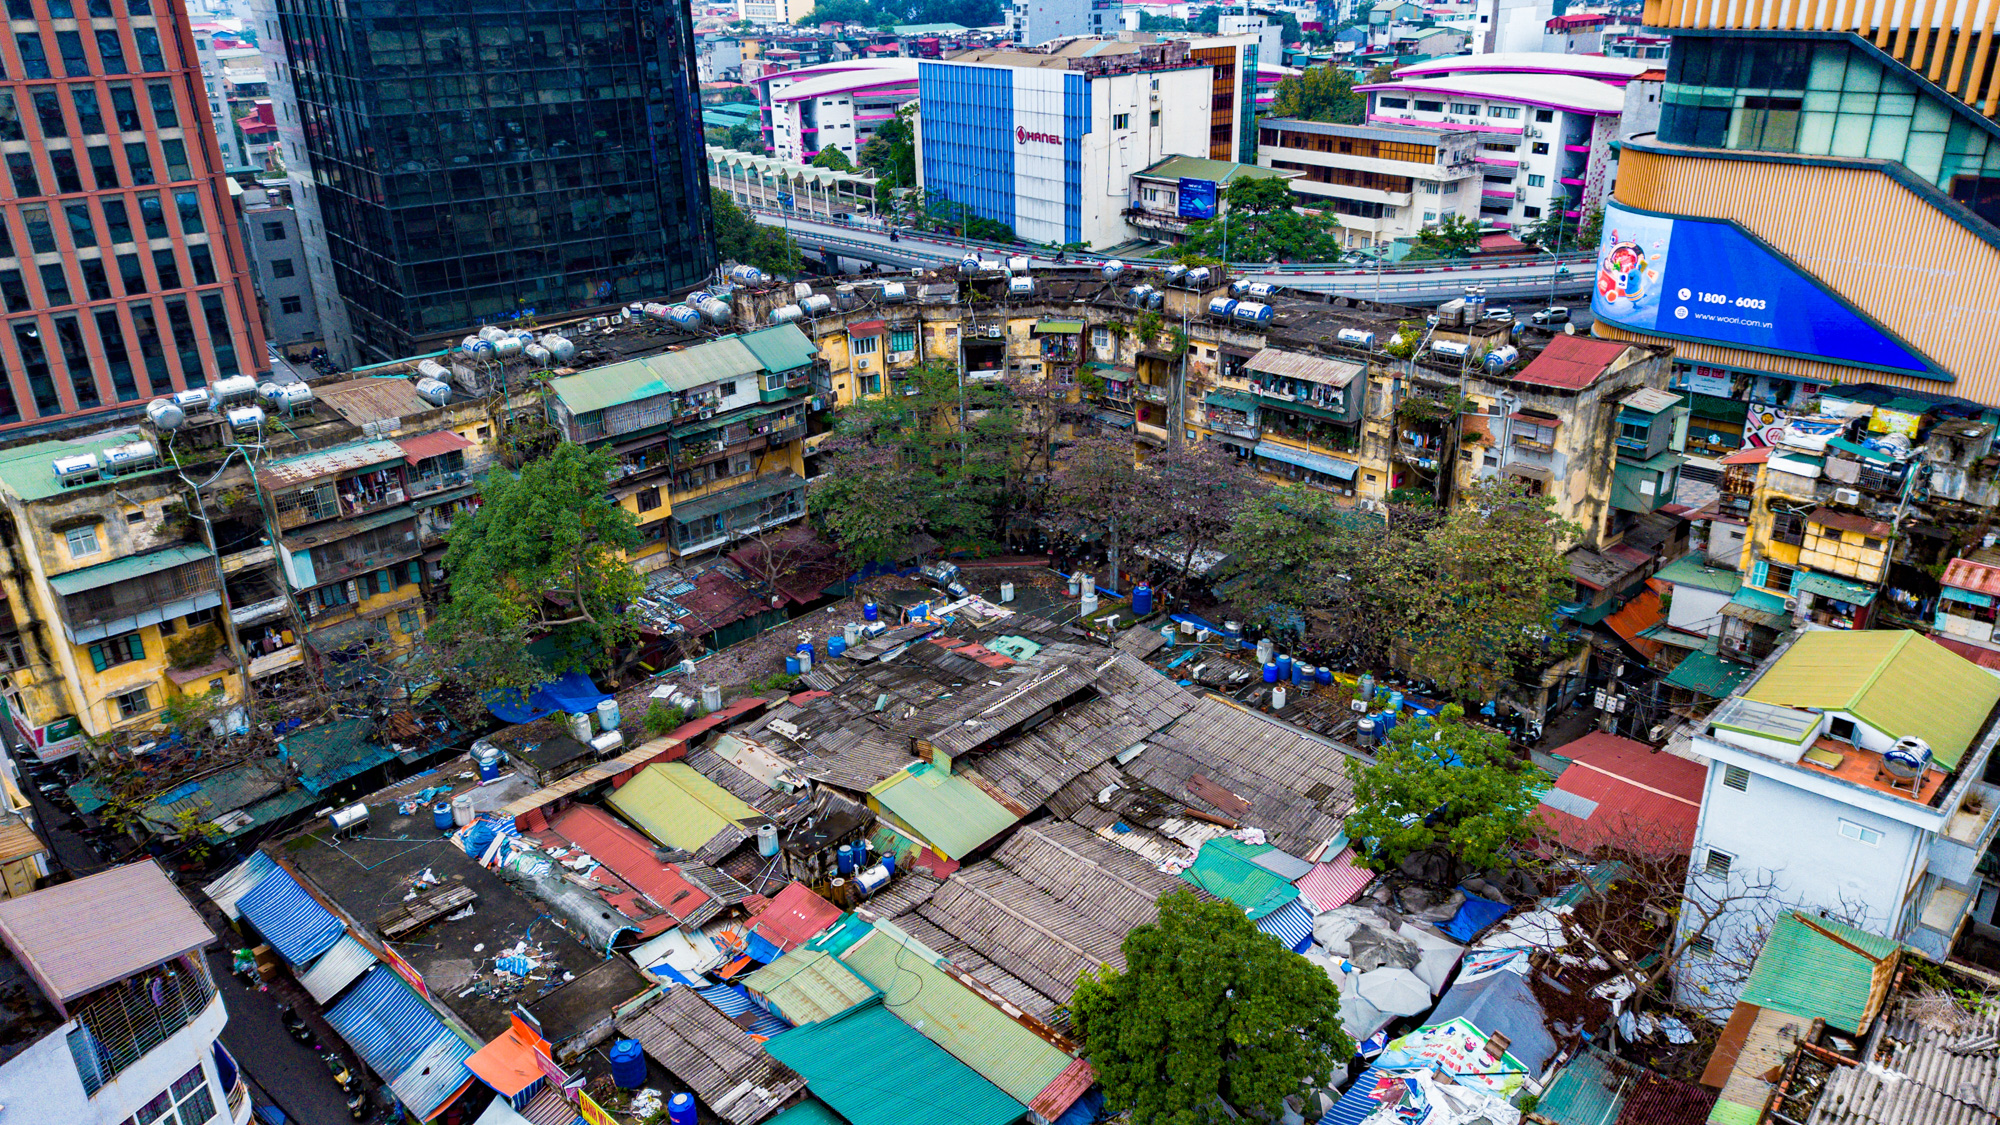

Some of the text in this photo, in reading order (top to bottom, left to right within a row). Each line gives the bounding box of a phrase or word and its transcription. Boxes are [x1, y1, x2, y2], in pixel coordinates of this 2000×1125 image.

[1026, 131, 1063, 146] HANEL
[1697, 291, 1727, 305] 1800
[1735, 297, 1767, 310] 6003
[1694, 312, 1773, 329] www.woori.com.vn
